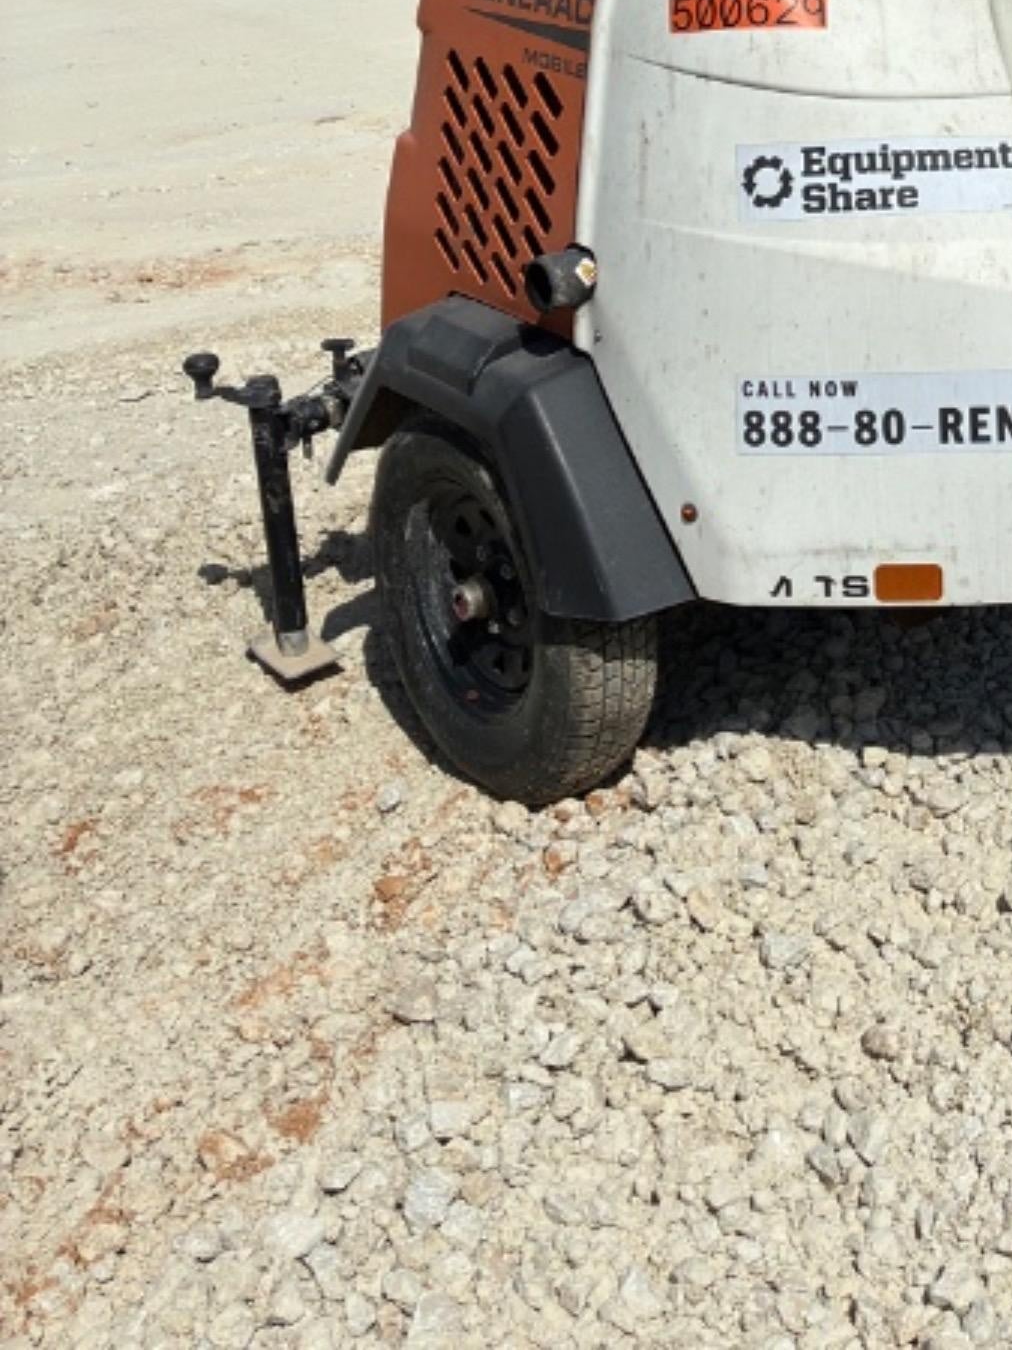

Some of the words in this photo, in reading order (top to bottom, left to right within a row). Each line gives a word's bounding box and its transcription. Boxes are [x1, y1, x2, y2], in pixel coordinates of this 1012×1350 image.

[802, 183, 919, 213] Share
[742, 380, 796, 398] CALL
[808, 380, 859, 398] NOW
